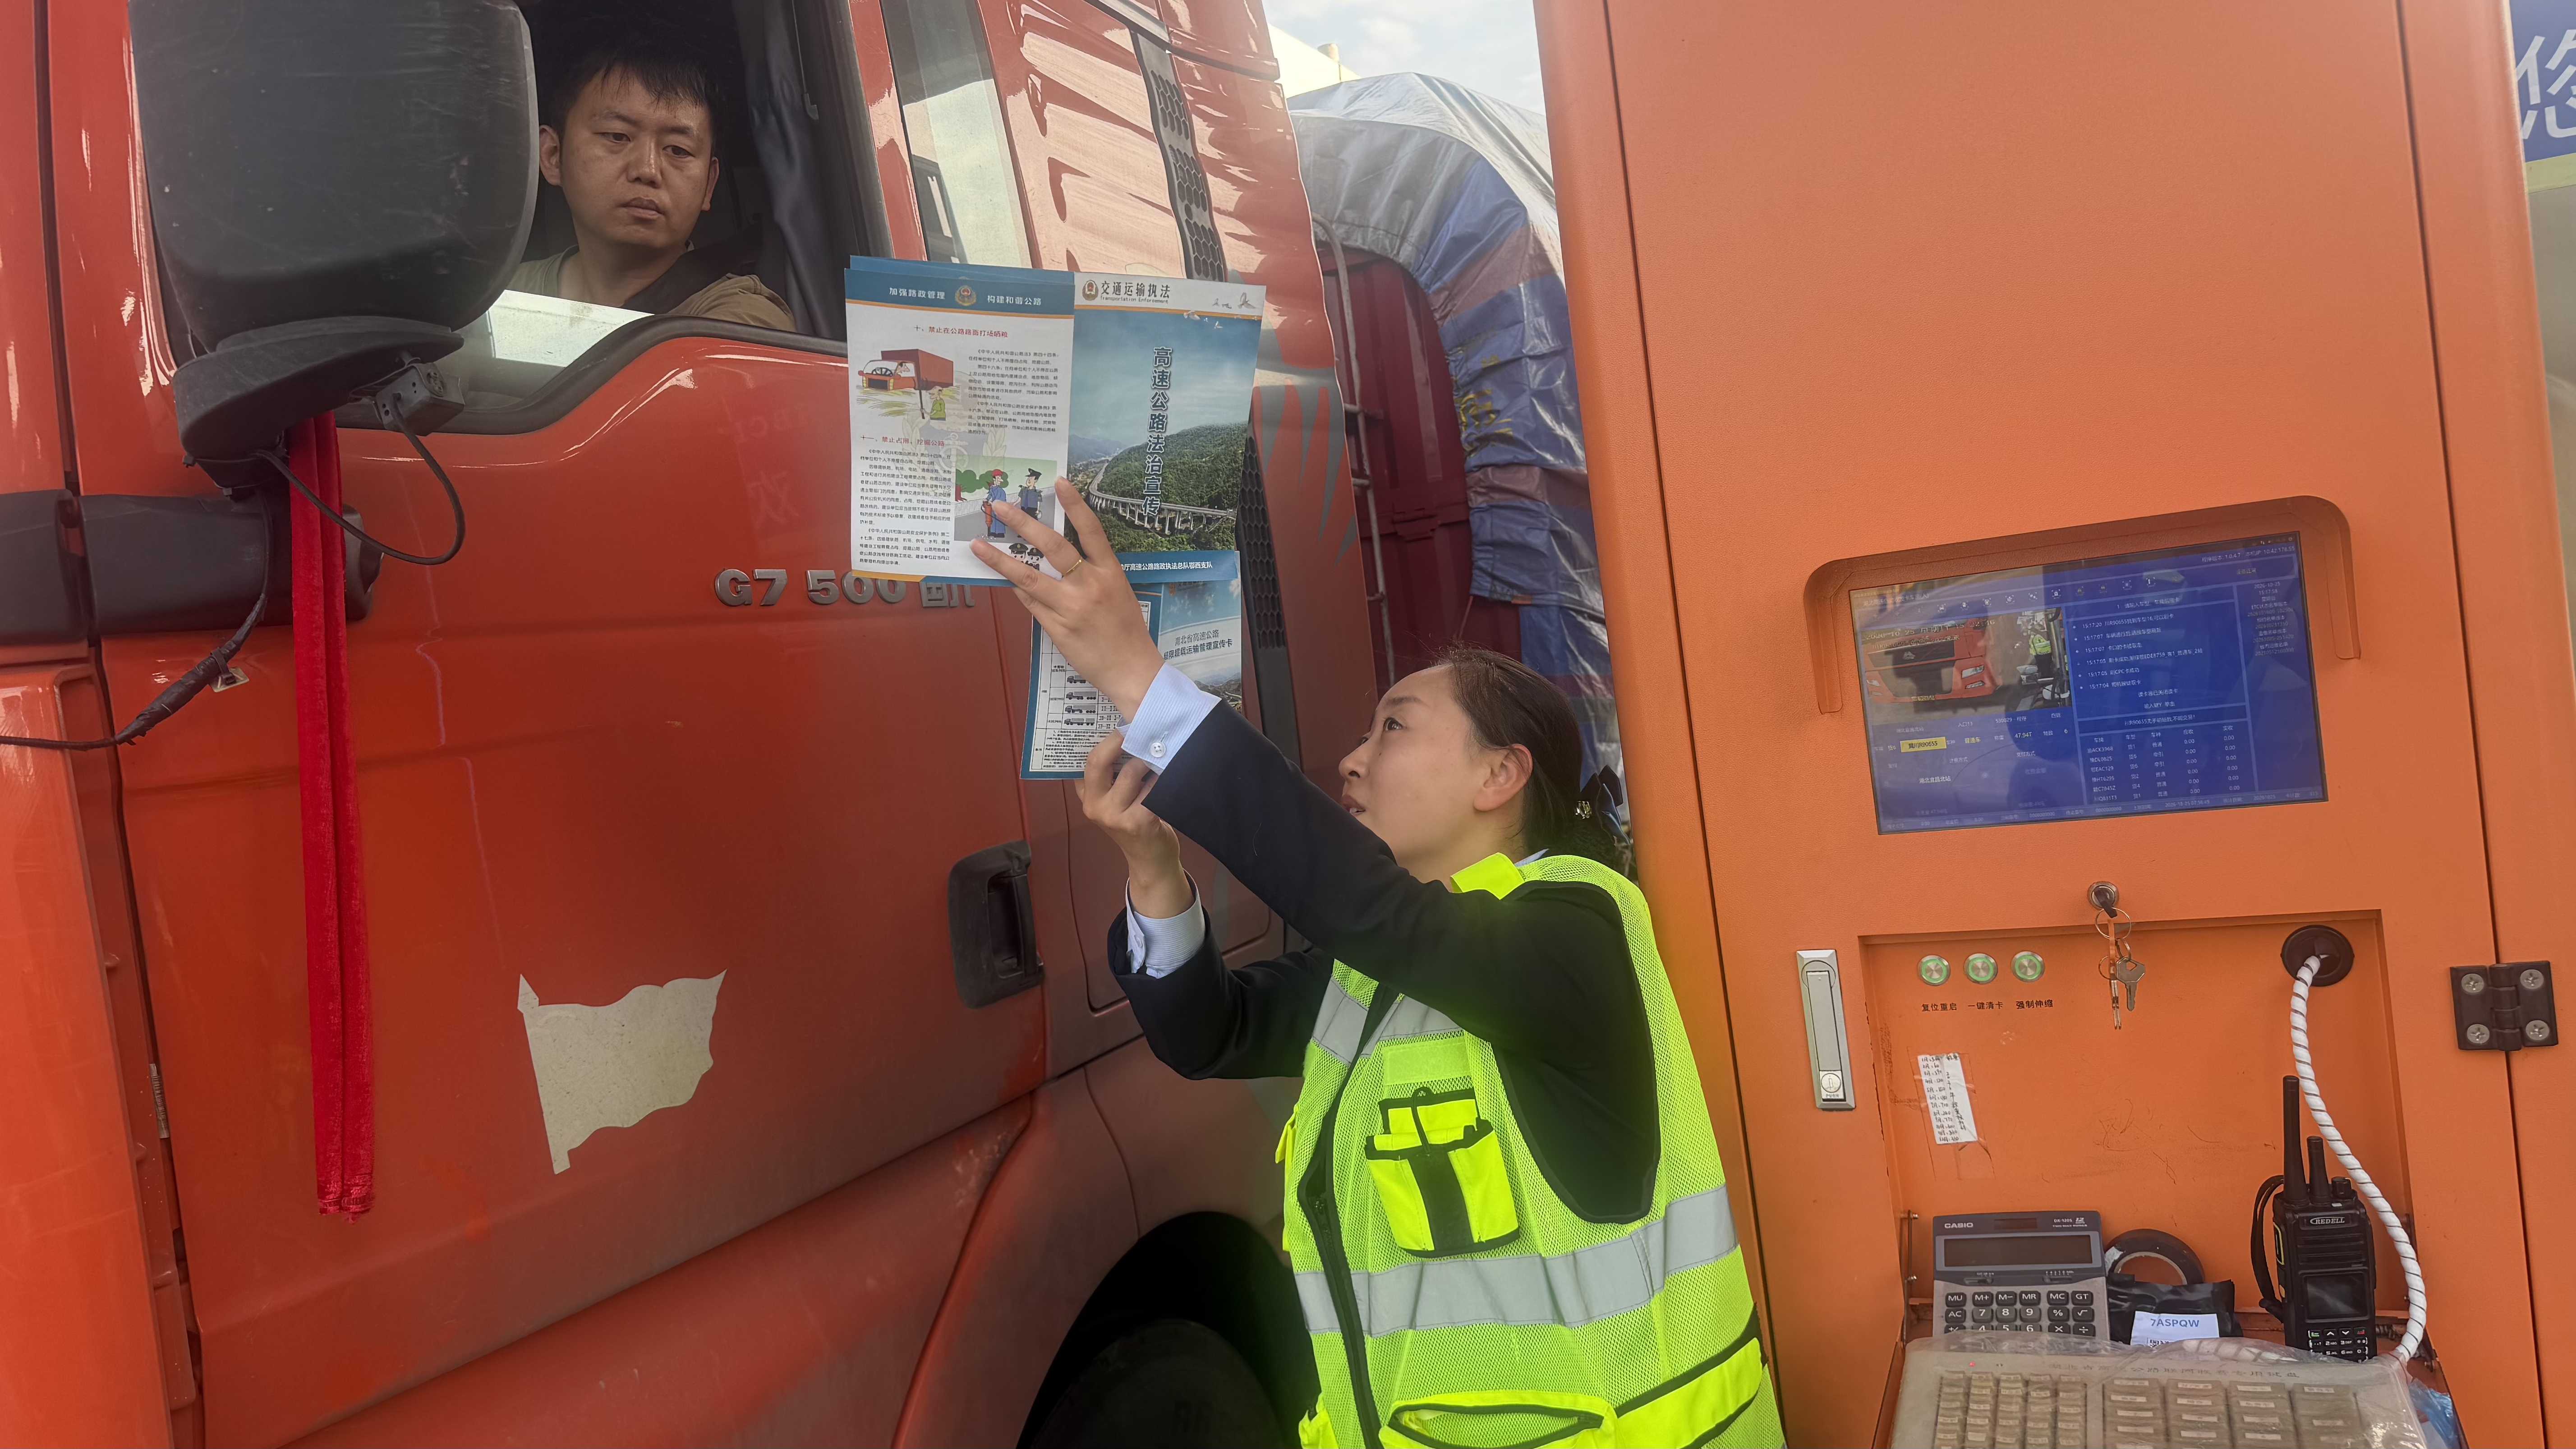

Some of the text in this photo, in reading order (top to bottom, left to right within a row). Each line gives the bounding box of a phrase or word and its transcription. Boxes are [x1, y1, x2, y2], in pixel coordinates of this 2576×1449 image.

[889, 287, 946, 300] 加强路政管理
[1101, 280, 1170, 299] 交通运输执法
[987, 294, 1042, 306] 构建和谐公路
[1142, 346, 1173, 516] 高速公路法治宣传
[715, 568, 788, 607] G7
[806, 569, 906, 606] 500
[1175, 630, 1219, 646] 湖北省高速公路
[1164, 639, 1233, 660] 超限超载运输管理宣传卡
[1918, 775, 1951, 784] 湖北宜昌北站
[1922, 1003, 1957, 1012] 复位重启
[1968, 1001, 2003, 1010] 一键清卡
[2016, 999, 2053, 1009] 强制伸缩
[2150, 1319, 2199, 1327] 7ASPQW
